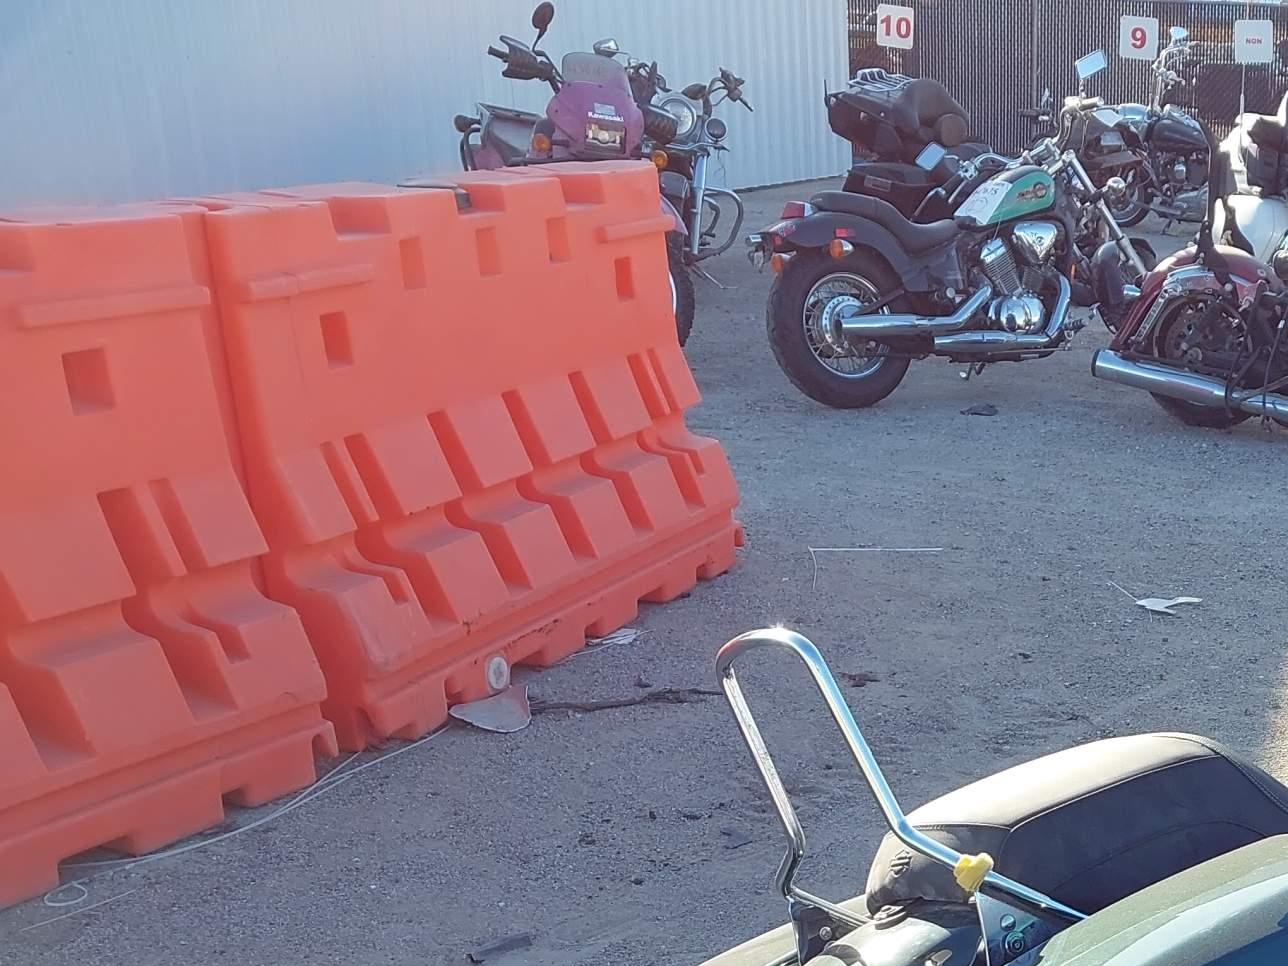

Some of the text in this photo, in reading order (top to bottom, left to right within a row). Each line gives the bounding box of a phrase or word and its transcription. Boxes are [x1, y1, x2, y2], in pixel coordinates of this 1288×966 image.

[880, 15, 912, 38] 10
[1131, 27, 1147, 49] 9
[587, 111, 624, 122] Kawasaki
